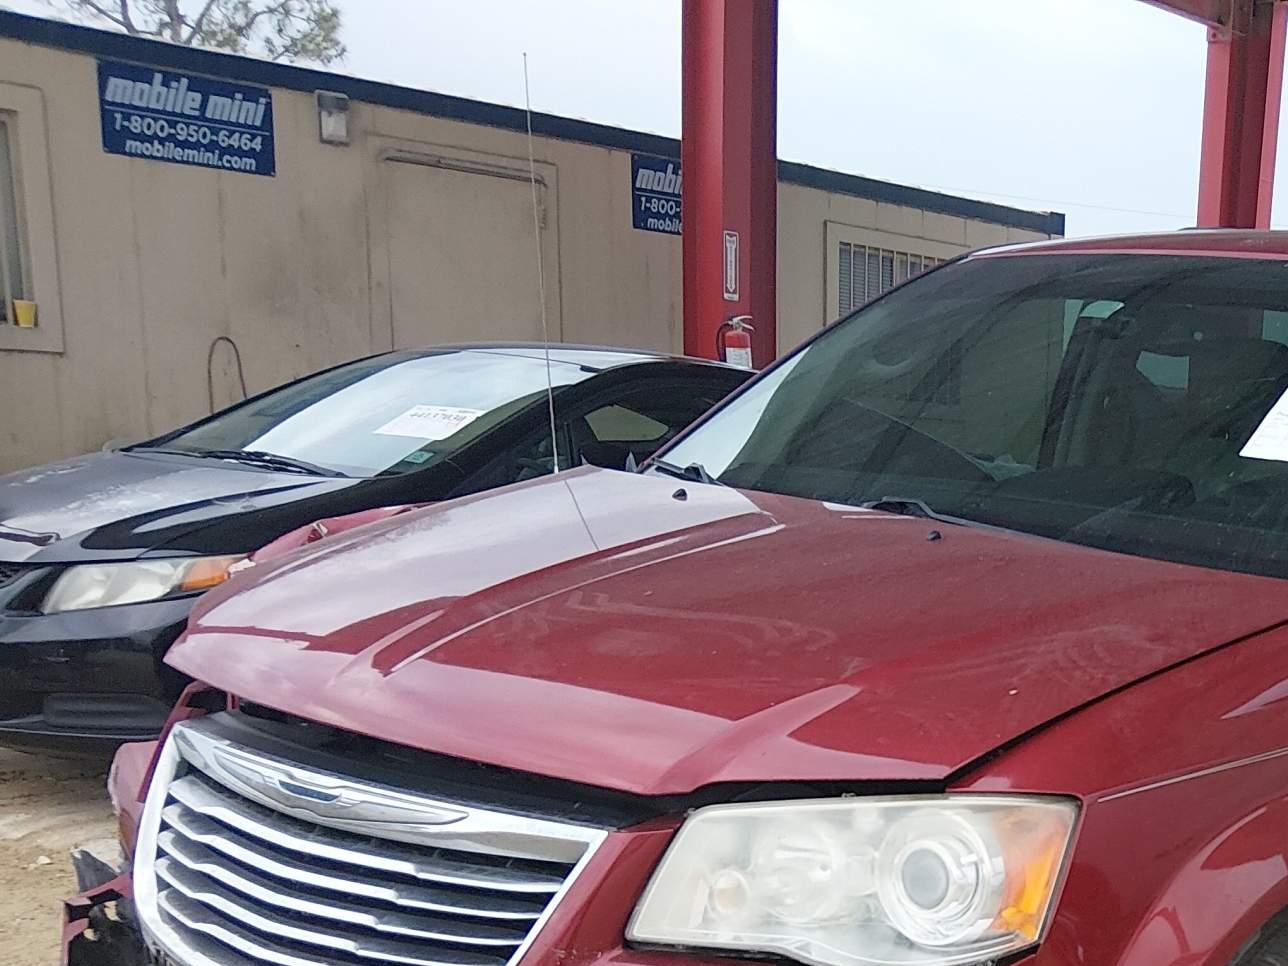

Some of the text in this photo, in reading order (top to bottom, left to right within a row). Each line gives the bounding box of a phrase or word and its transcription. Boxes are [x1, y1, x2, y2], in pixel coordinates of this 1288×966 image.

[105, 73, 266, 127] mobile mini
[113, 112, 263, 152] 1-800-950-6464
[125, 139, 256, 171] mobilemini.com
